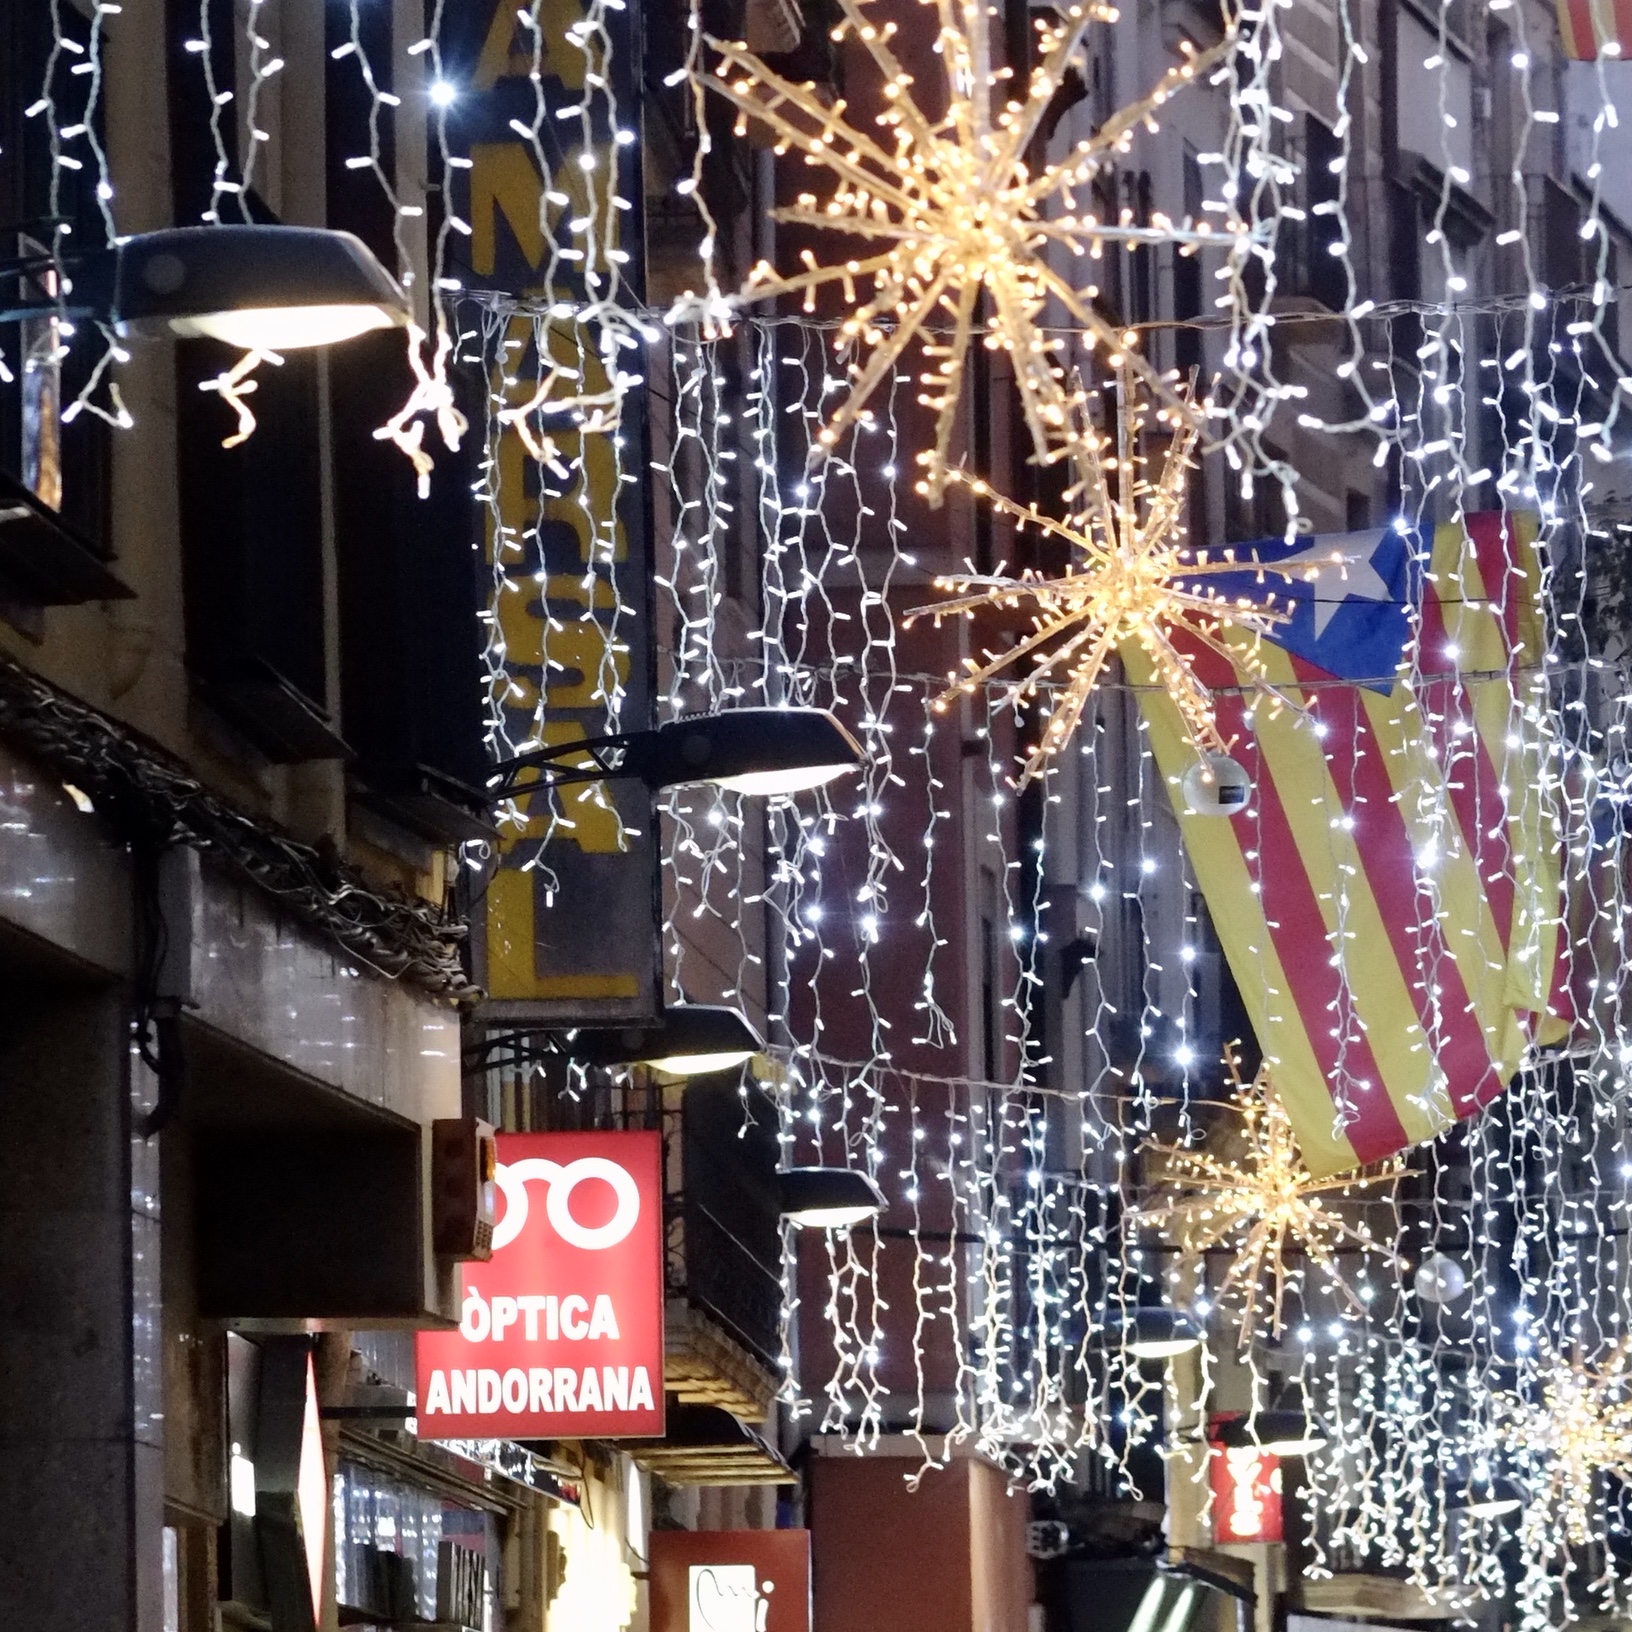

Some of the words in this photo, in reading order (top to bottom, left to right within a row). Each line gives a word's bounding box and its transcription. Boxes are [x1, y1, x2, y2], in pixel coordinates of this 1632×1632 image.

[470, 142, 639, 998] MARSAL
[459, 1286, 620, 1343] ÒPTICA
[425, 1366, 655, 1414] ANDORRANA
